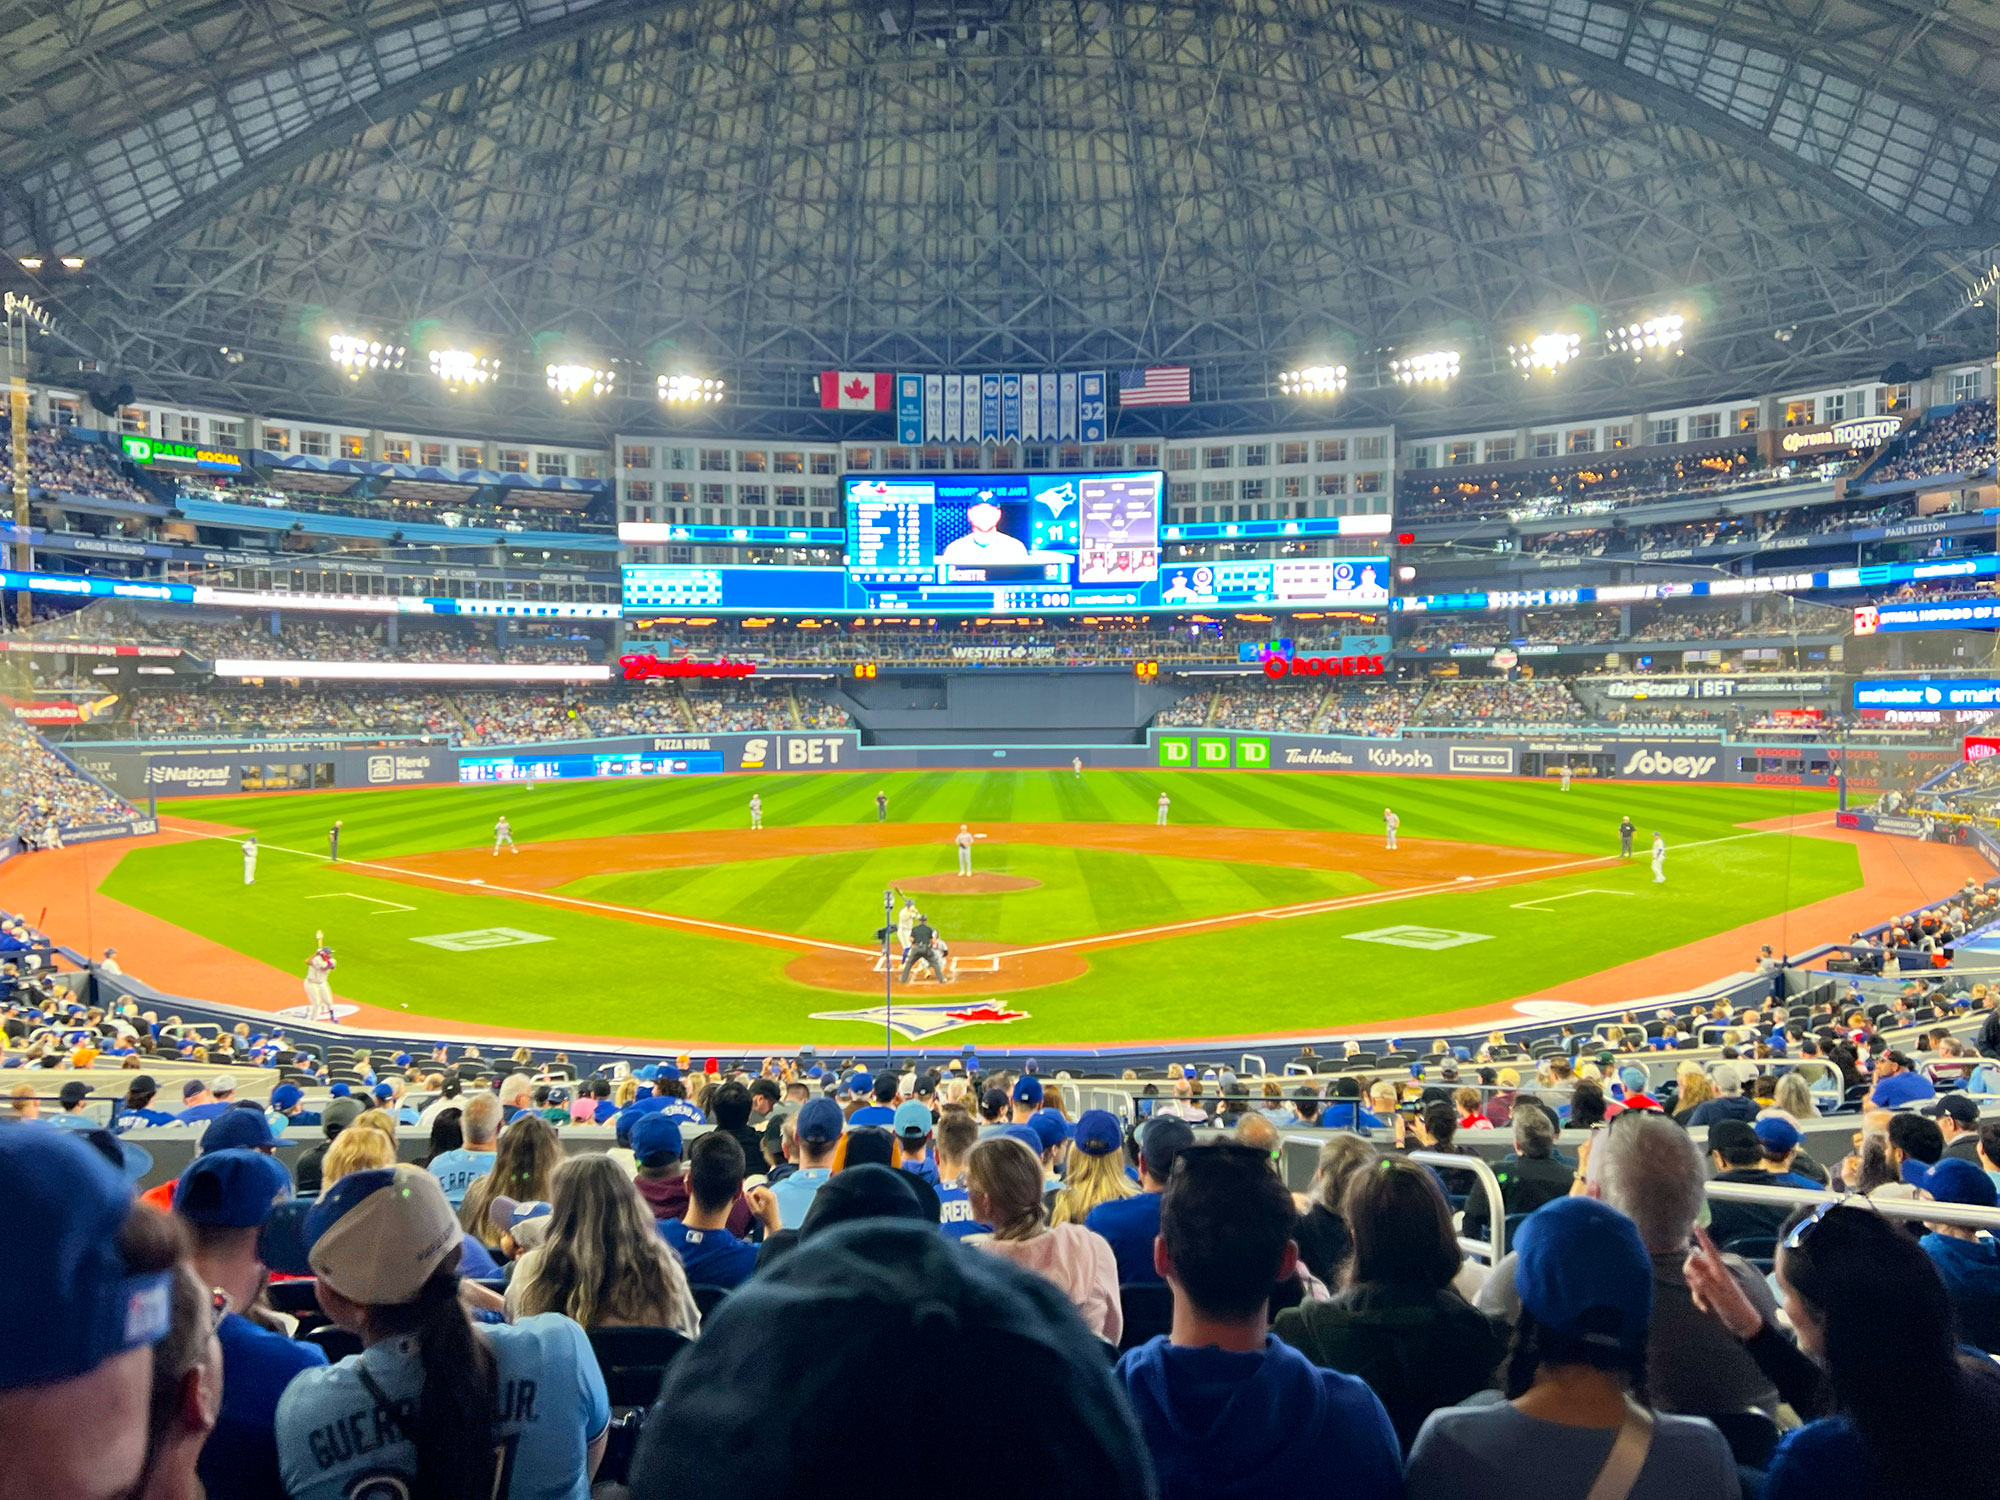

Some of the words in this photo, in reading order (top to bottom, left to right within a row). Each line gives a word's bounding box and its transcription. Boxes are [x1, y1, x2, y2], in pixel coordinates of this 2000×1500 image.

[1081, 402, 1104, 420] 32
[1782, 431, 1833, 452] Corona
[1834, 420, 1901, 443] ROOFTOP
[1851, 437, 1881, 449] PATIO
[124, 439, 151, 461] TD
[152, 441, 197, 458] PARK
[197, 450, 240, 465] SOCIAL
[1885, 528, 1906, 538] PAUL
[1908, 522, 1946, 535] BEESTON
[1778, 538, 1808, 549] GILLICK
[1661, 550, 1692, 560] GASTON
[1919, 608, 1972, 621] HOTDOG
[1973, 606, 1993, 619] OF
[98, 646, 116, 656] Jays
[952, 647, 1011, 659] WESTJET
[618, 655, 755, 678] Budweiser
[1291, 656, 1384, 676] ROGERS
[1607, 682, 1689, 698] theScore
[1701, 681, 1735, 696] BET
[1617, 723, 1682, 735] CANADA
[654, 739, 682, 750] PIZZA
[684, 738, 710, 749] NOVA
[742, 739, 768, 762] S
[788, 738, 844, 764] BET
[1162, 743, 1188, 760] TD
[1200, 743, 1227, 760] TD
[1239, 743, 1266, 761] TD
[1284, 748, 1308, 764] Tim
[1308, 747, 1352, 764] Hortons
[1368, 748, 1433, 767] Kubota
[1765, 748, 1802, 757] ROGERS
[1967, 745, 1997, 760] HEINZ
[395, 757, 430, 768] Here's
[1457, 755, 1480, 765] THE
[1482, 755, 1506, 766] KEG
[1623, 750, 1716, 778] Sobeys
[165, 766, 231, 780] National
[1765, 772, 1802, 781] ROGERS
[131, 822, 155, 834] VISA
